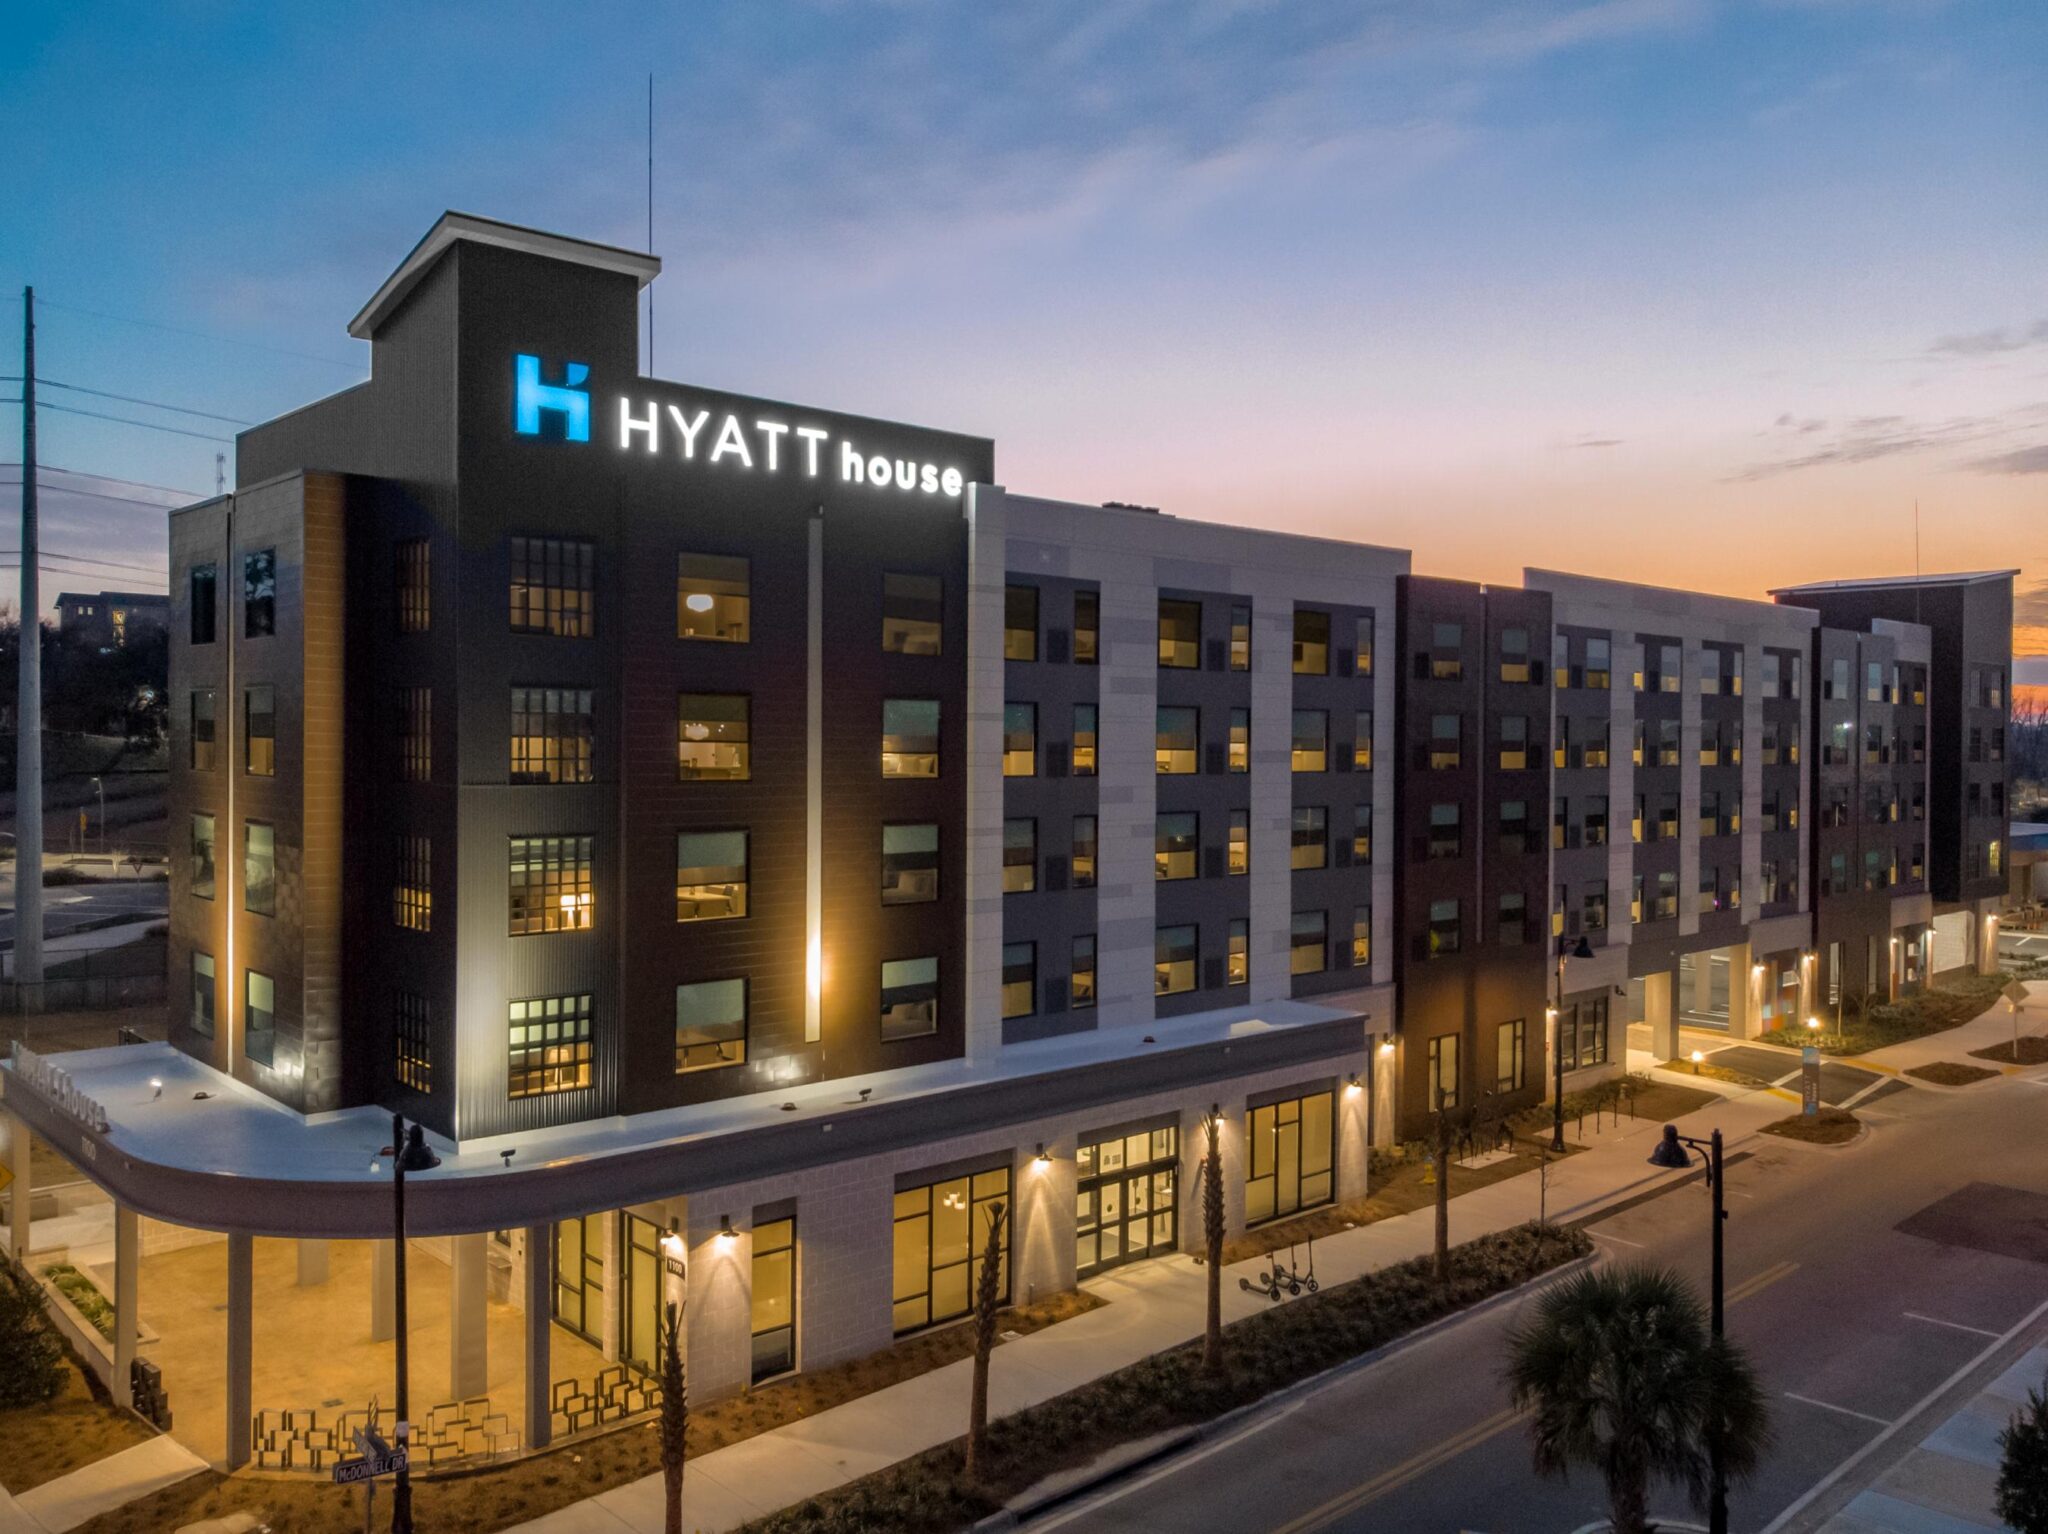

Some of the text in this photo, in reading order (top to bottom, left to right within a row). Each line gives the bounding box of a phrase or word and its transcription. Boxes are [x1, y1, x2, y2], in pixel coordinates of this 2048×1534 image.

[619, 397, 963, 497] HYATT house
[669, 1260, 682, 1274] 1100
[392, 1456, 404, 1471] DR
